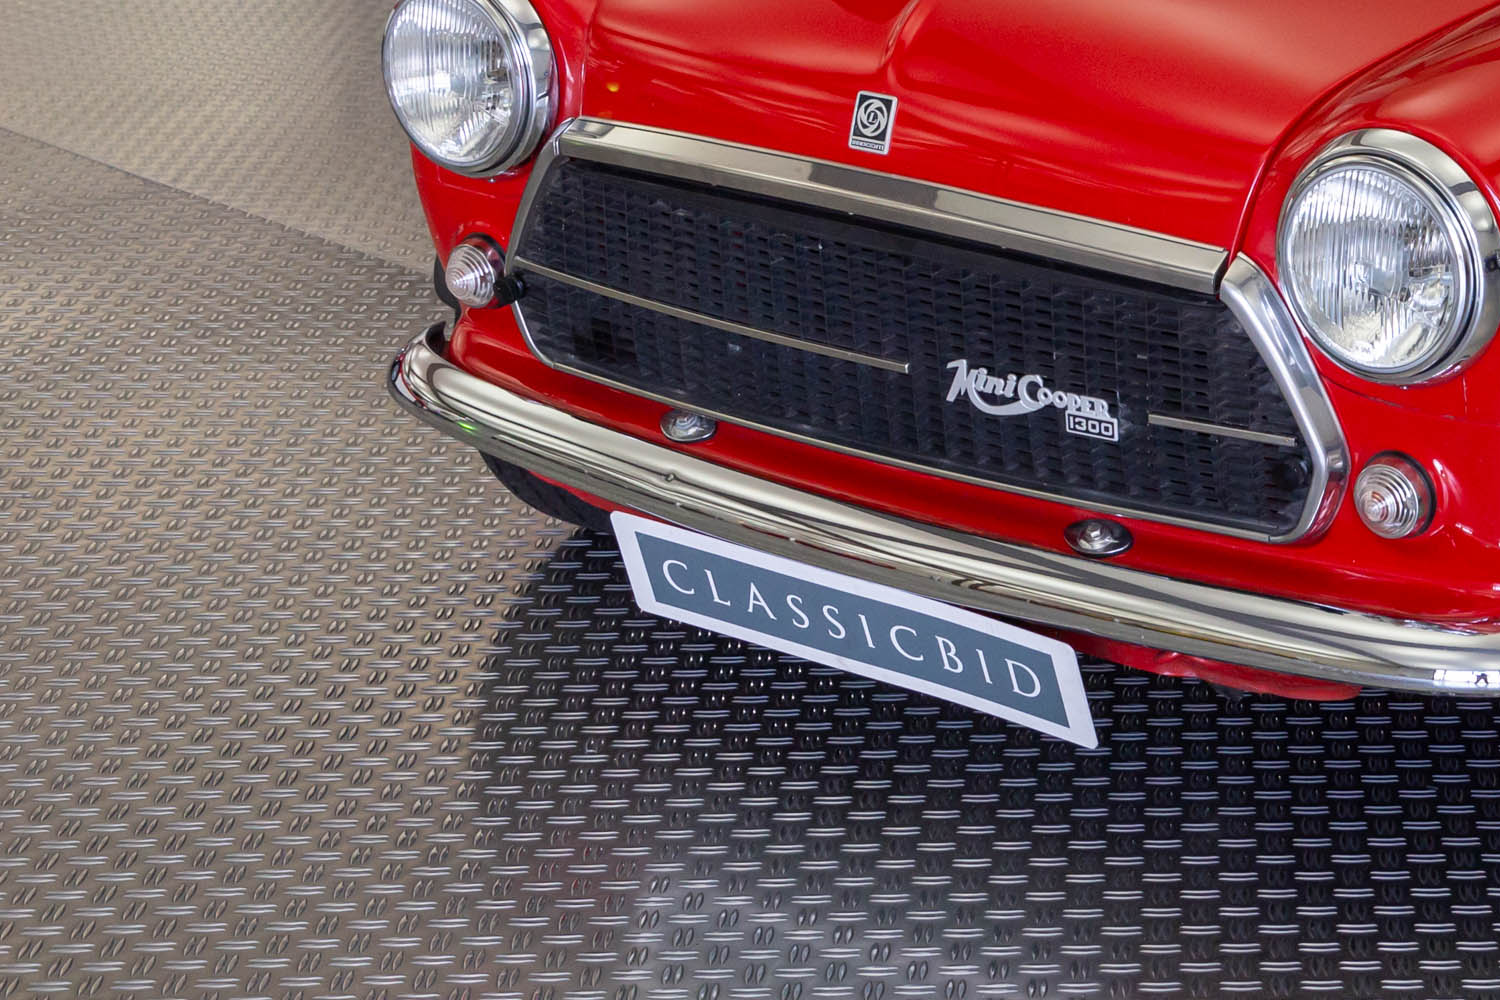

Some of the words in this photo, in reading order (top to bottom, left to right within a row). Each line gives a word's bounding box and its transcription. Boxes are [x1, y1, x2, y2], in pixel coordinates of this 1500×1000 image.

[946, 359, 1016, 415] Mini
[1069, 415, 1113, 437] 1300
[661, 559, 1042, 699] CLASSICBID
